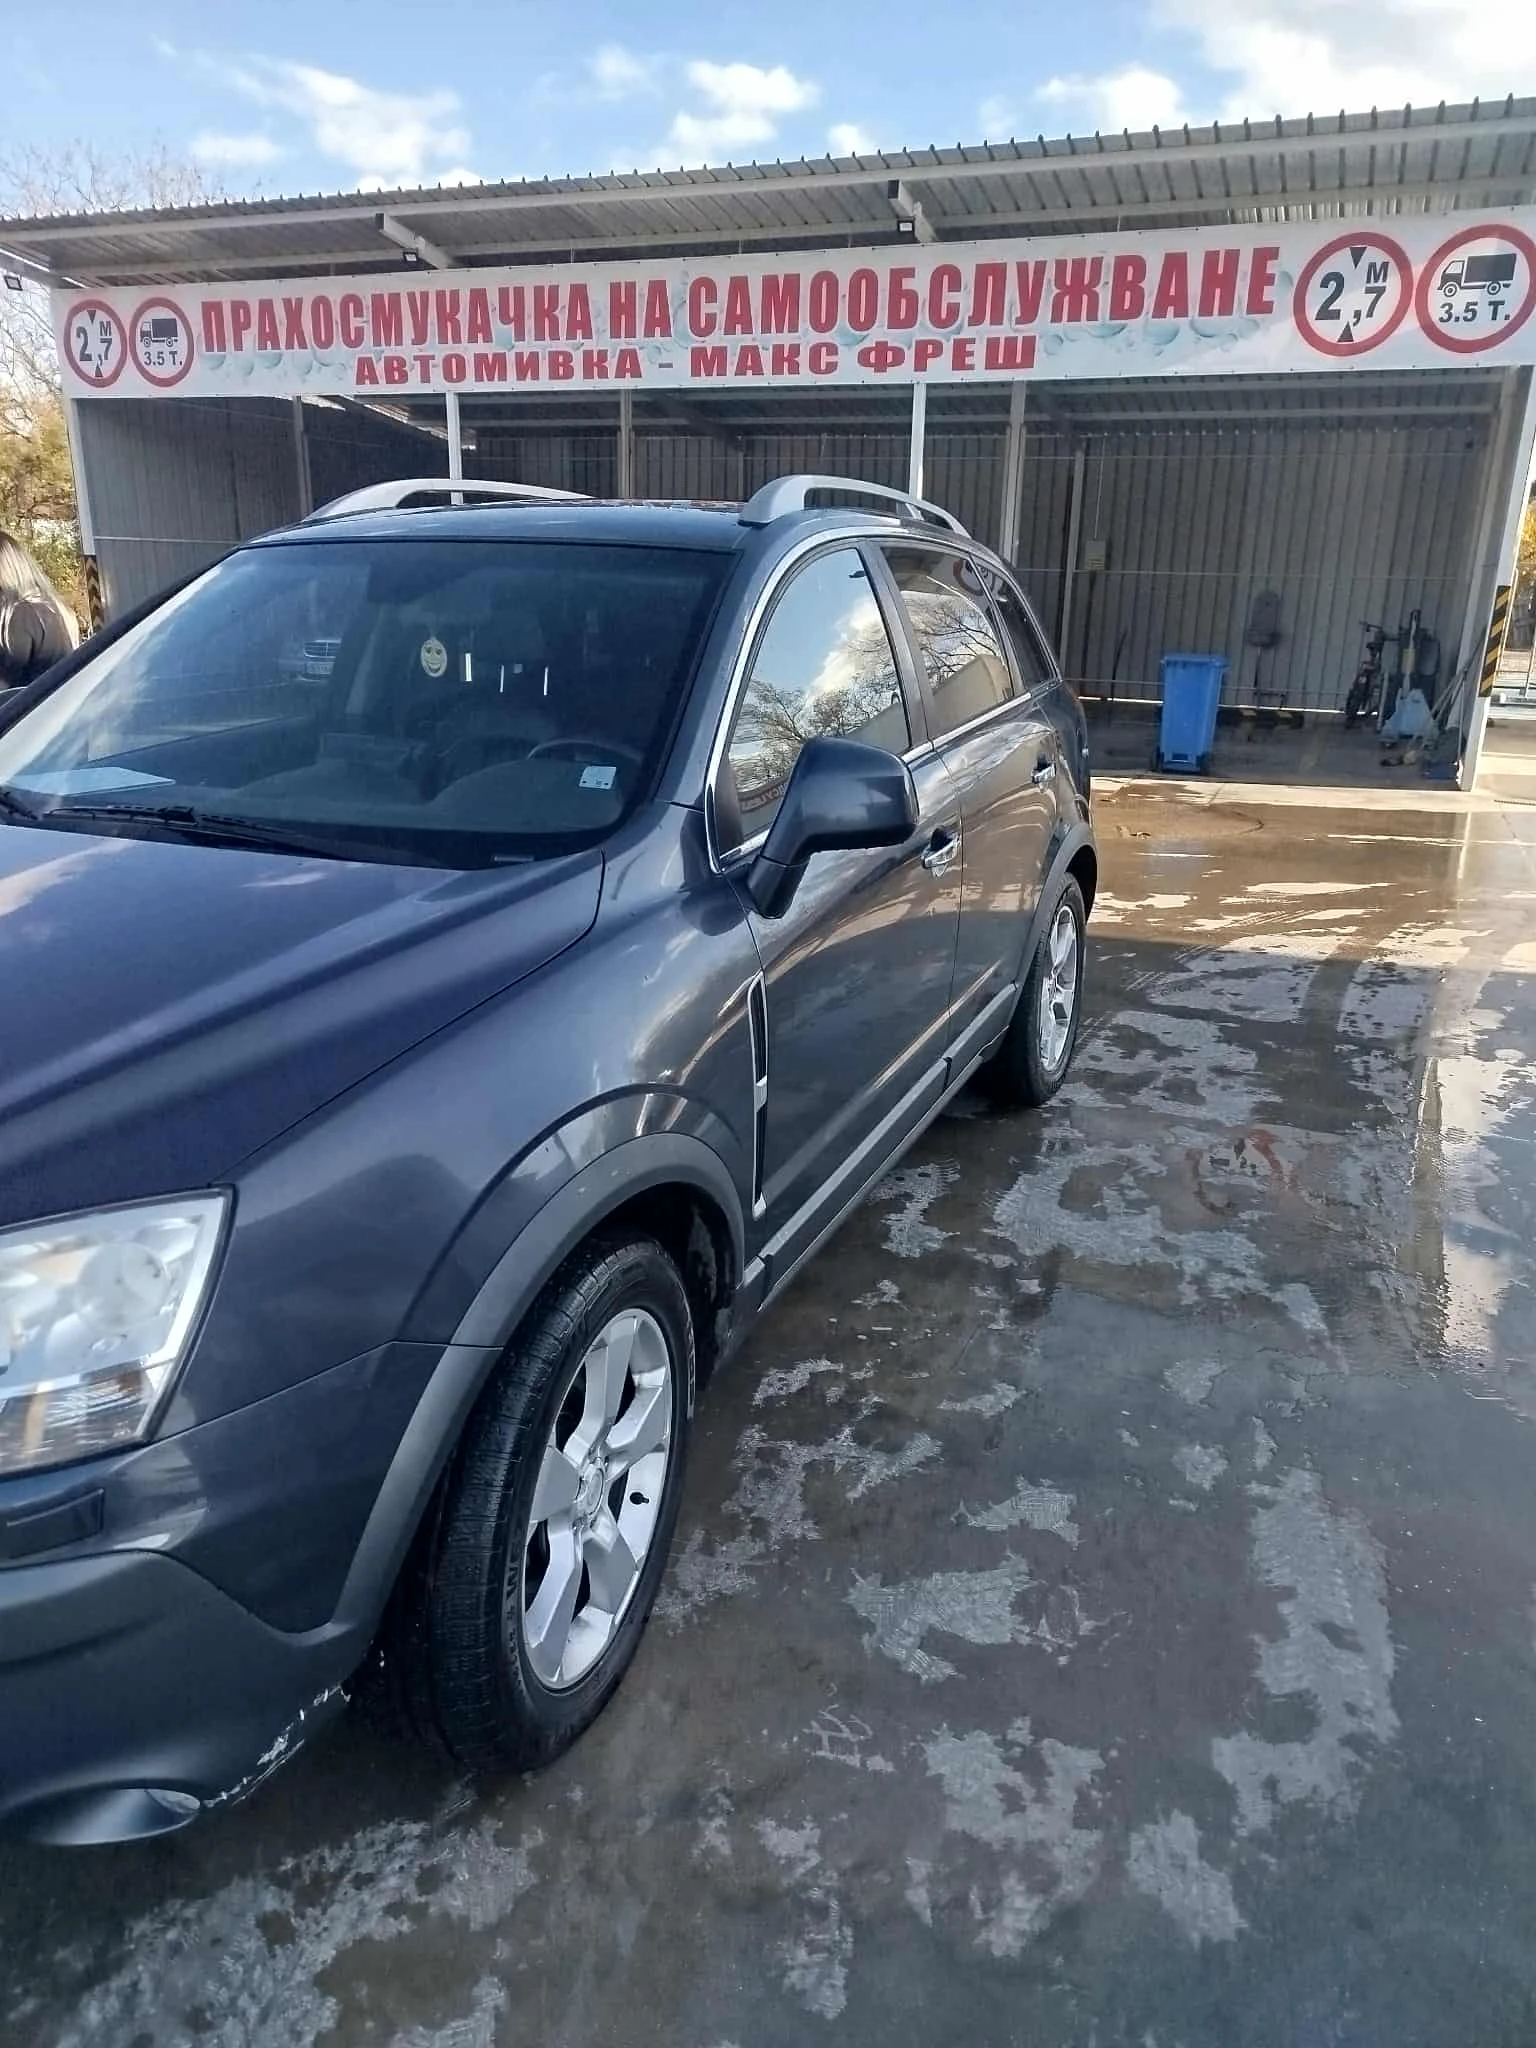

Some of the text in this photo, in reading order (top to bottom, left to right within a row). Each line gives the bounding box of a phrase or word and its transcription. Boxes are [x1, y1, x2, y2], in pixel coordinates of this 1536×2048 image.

[1366, 261, 1389, 284] М
[201, 246, 1280, 352] ПРАХОСМУКАЧКА НА САМООБСЛУЖВАНЕ
[1439, 300, 1511, 323] 3.5 Т.
[144, 351, 165, 366] 3.5
[355, 349, 643, 386] АВТОМИВКА
[690, 342, 839, 378] МАКС
[857, 335, 1037, 374] ФРЕШ
